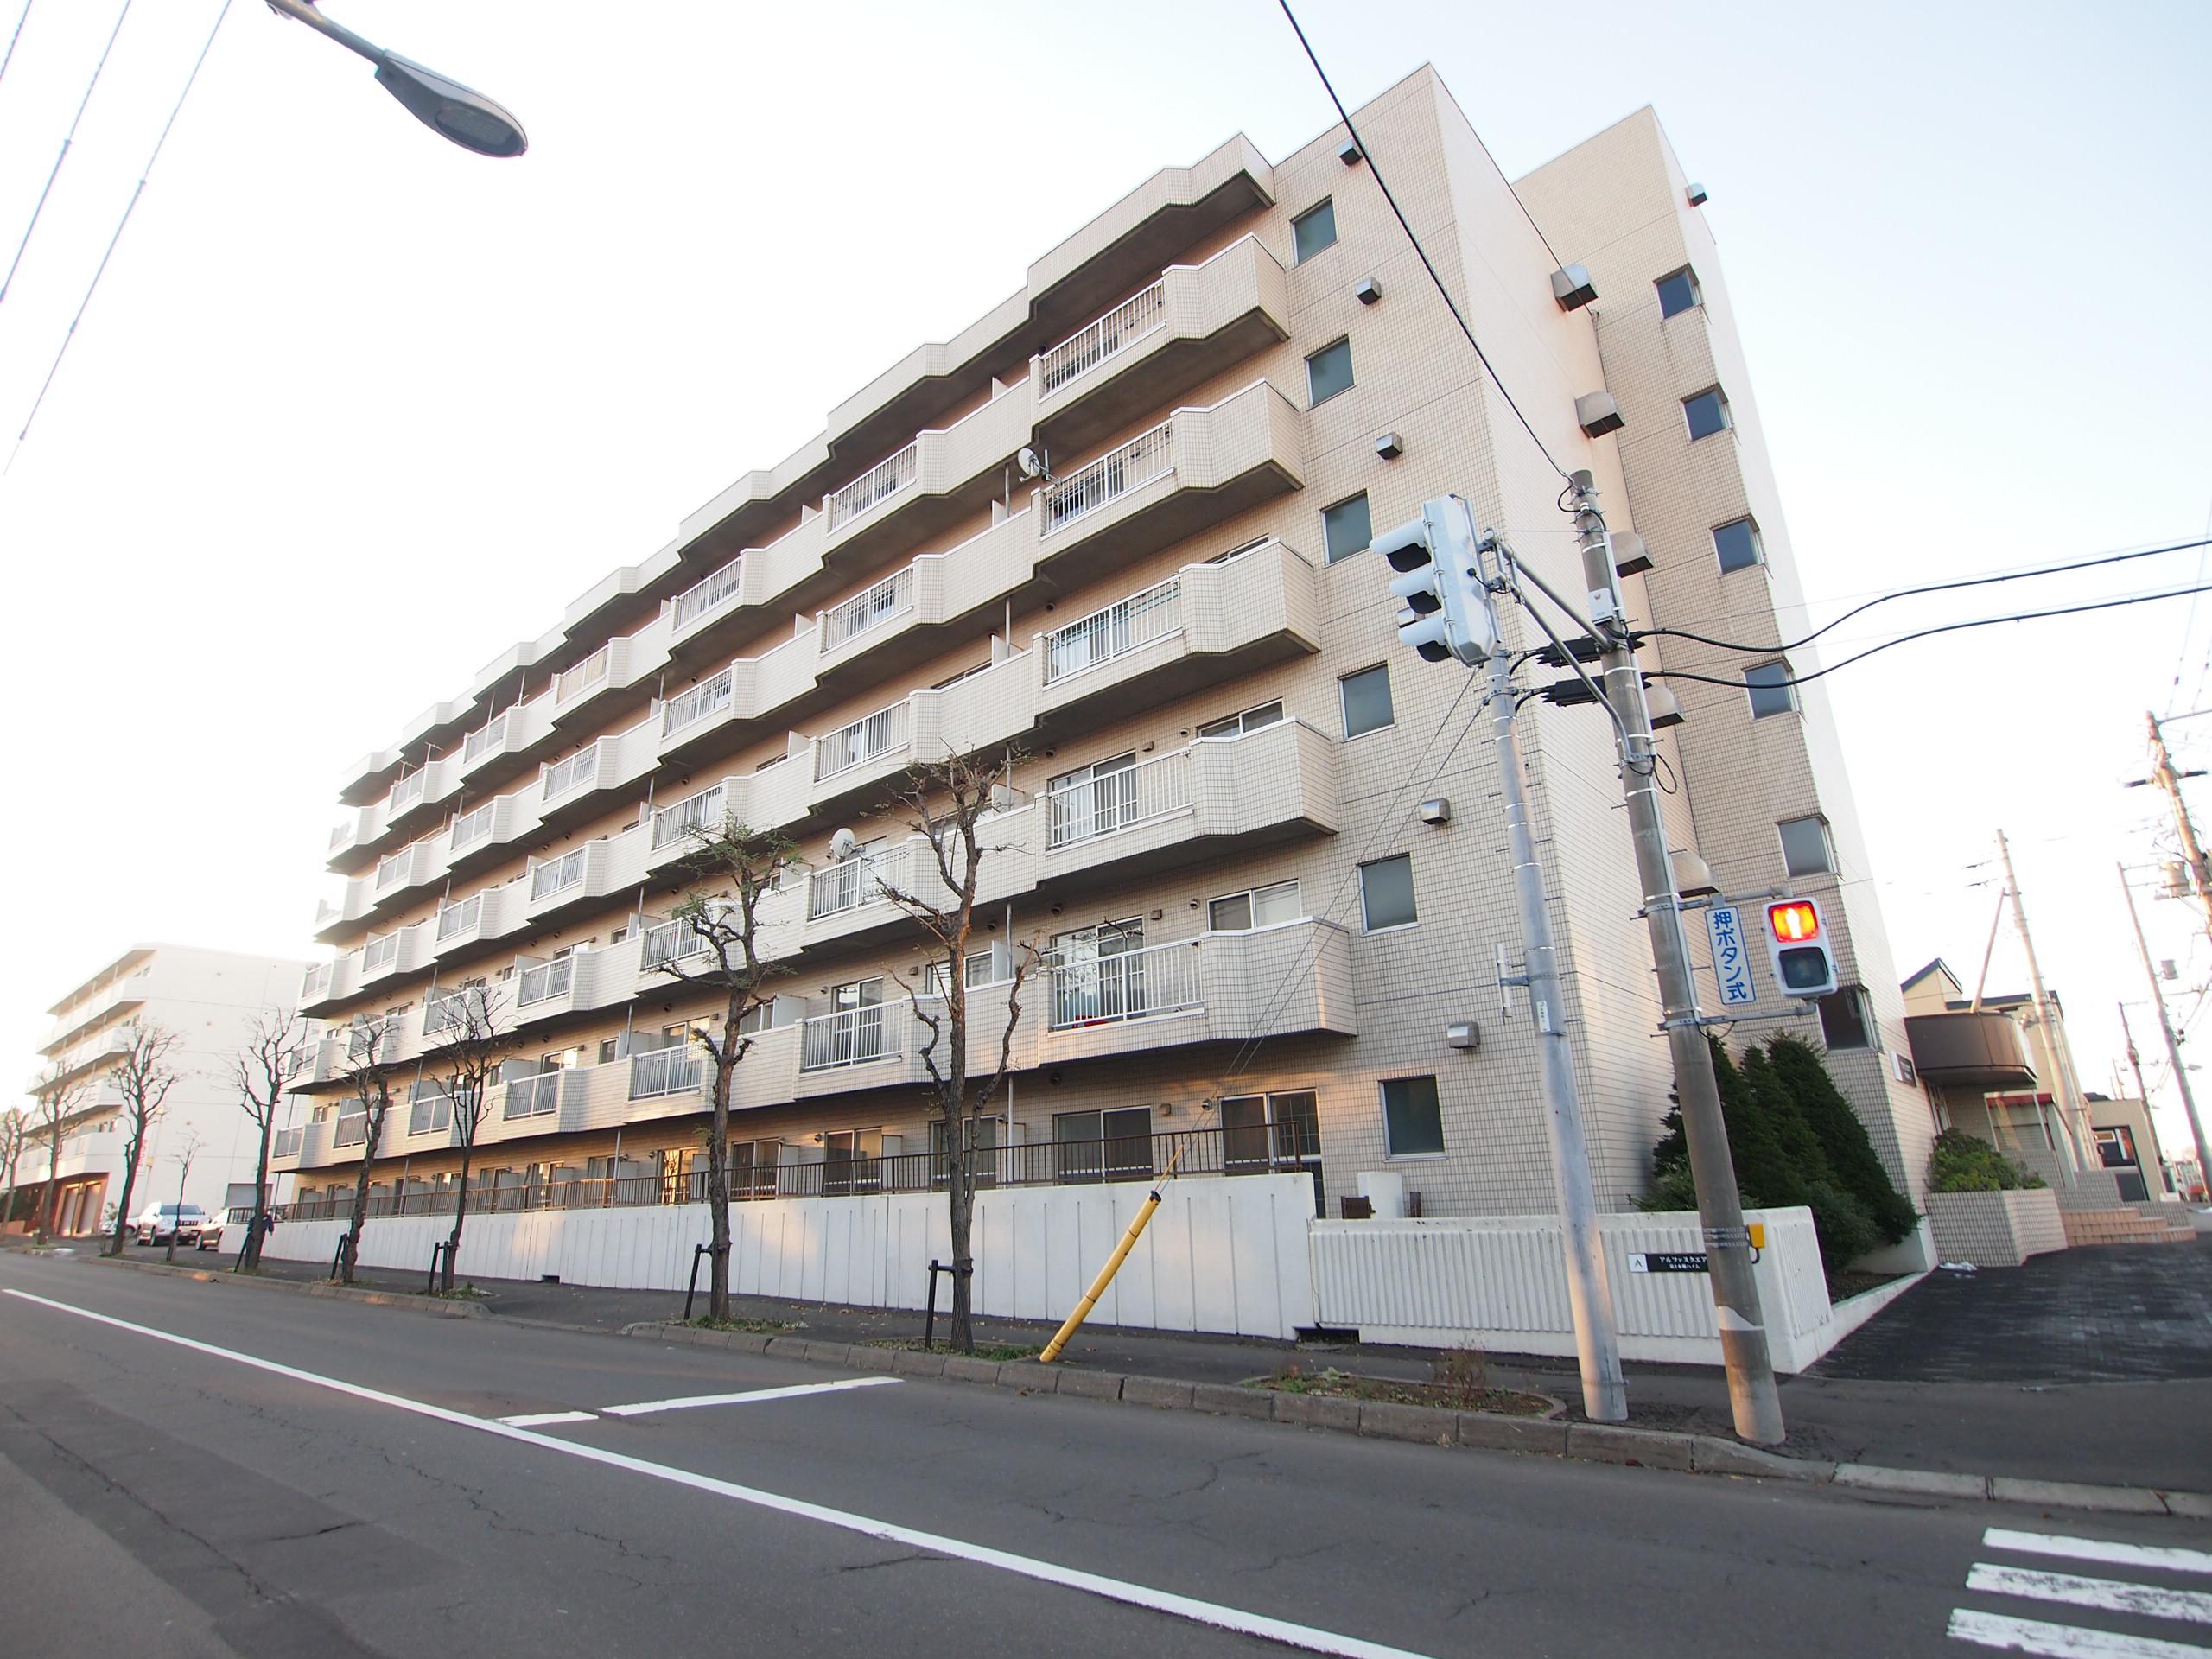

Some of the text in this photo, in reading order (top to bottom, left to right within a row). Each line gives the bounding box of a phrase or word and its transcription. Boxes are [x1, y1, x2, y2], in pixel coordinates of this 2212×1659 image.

[1713, 911, 1747, 1001] 押ボタン式
